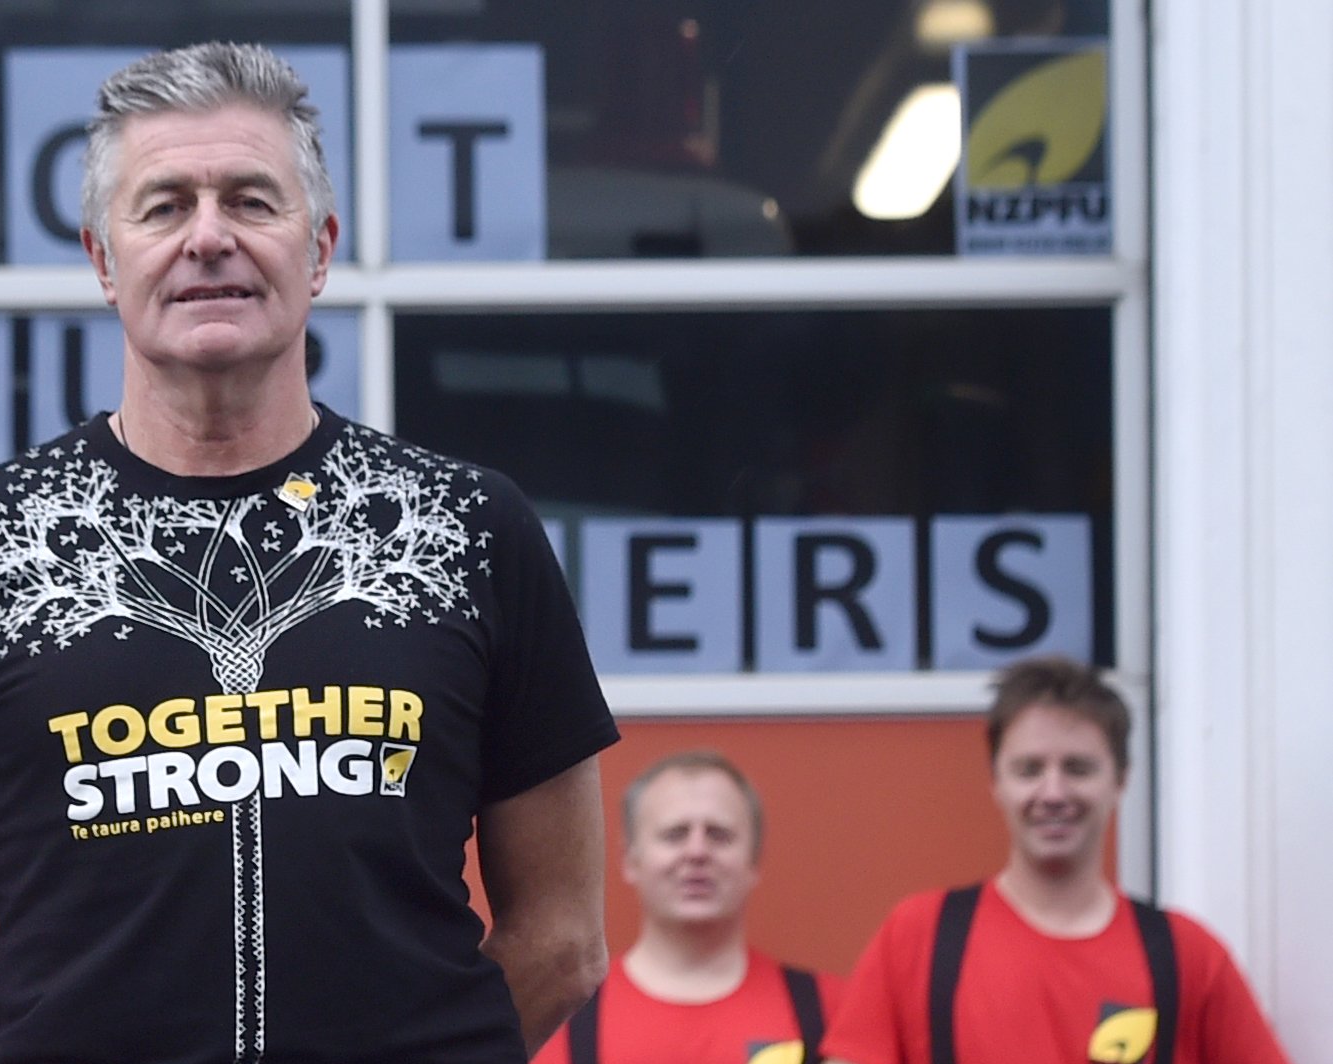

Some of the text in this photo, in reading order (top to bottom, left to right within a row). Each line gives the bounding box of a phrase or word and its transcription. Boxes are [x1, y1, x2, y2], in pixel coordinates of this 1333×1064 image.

[48, 686, 425, 763] TOGETHER
[64, 740, 374, 822] STRONG
[70, 810, 225, 841] Te taura paihere
